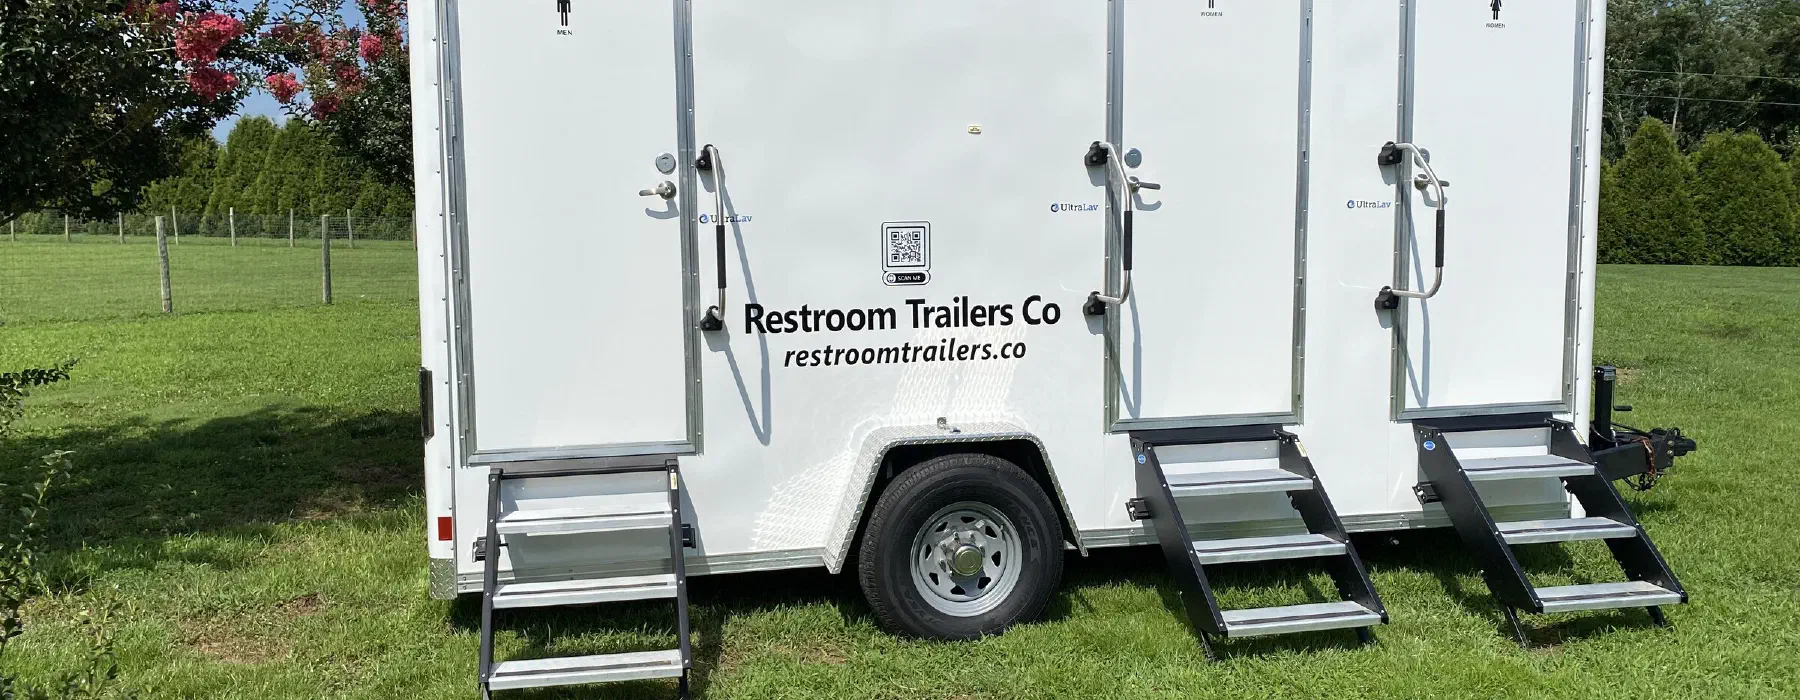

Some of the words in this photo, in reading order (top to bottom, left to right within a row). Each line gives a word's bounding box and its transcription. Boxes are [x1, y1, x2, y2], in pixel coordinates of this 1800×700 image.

[1060, 203, 1099, 212] UltraLav
[1356, 200, 1392, 209] UltraLav
[709, 213, 753, 223] UraLav
[744, 302, 896, 334] Restroom
[905, 296, 1013, 328] Trailers
[1022, 294, 1061, 325] Co
[784, 337, 1026, 367] restroomtrailers.co
